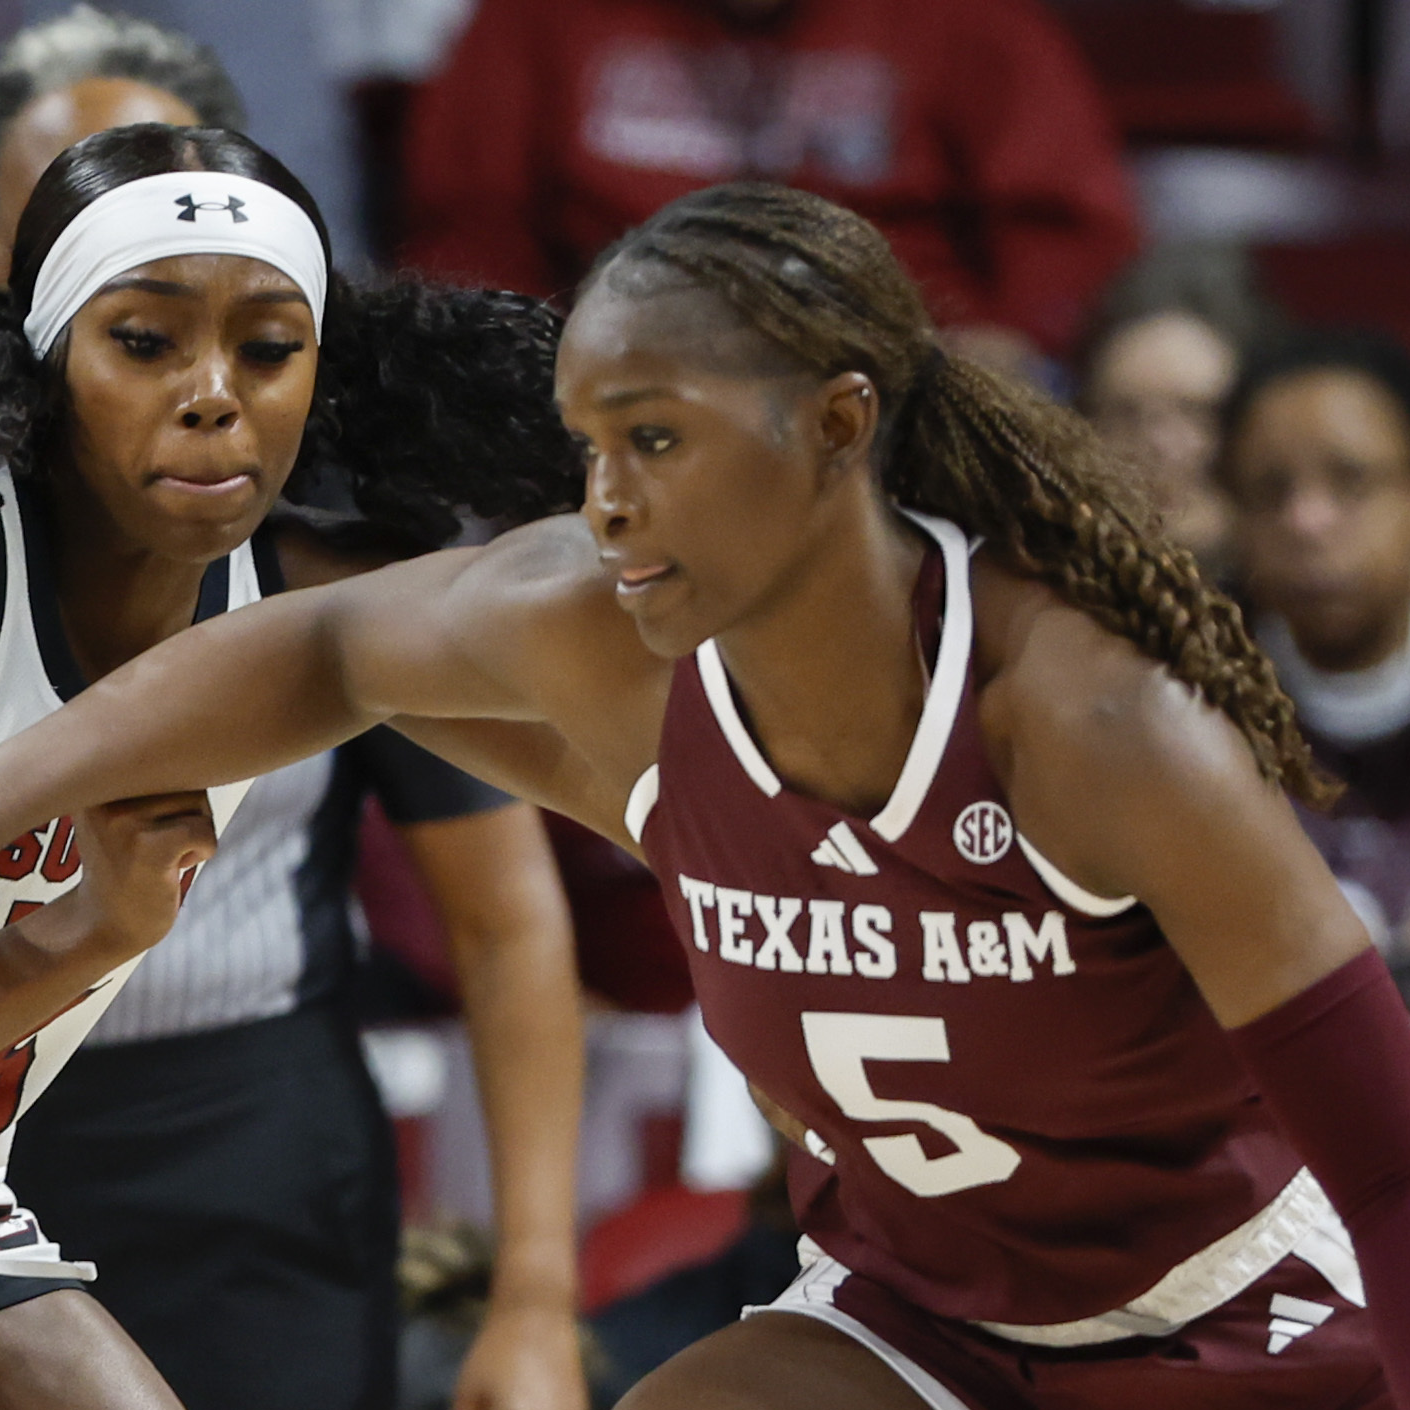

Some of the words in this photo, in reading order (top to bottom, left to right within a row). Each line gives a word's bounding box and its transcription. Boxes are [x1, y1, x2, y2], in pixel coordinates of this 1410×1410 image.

[957, 804, 1010, 862] SEC
[678, 873, 897, 979] TEXAS
[919, 909, 1076, 984] A&M
[801, 1011, 1022, 1198] 5
